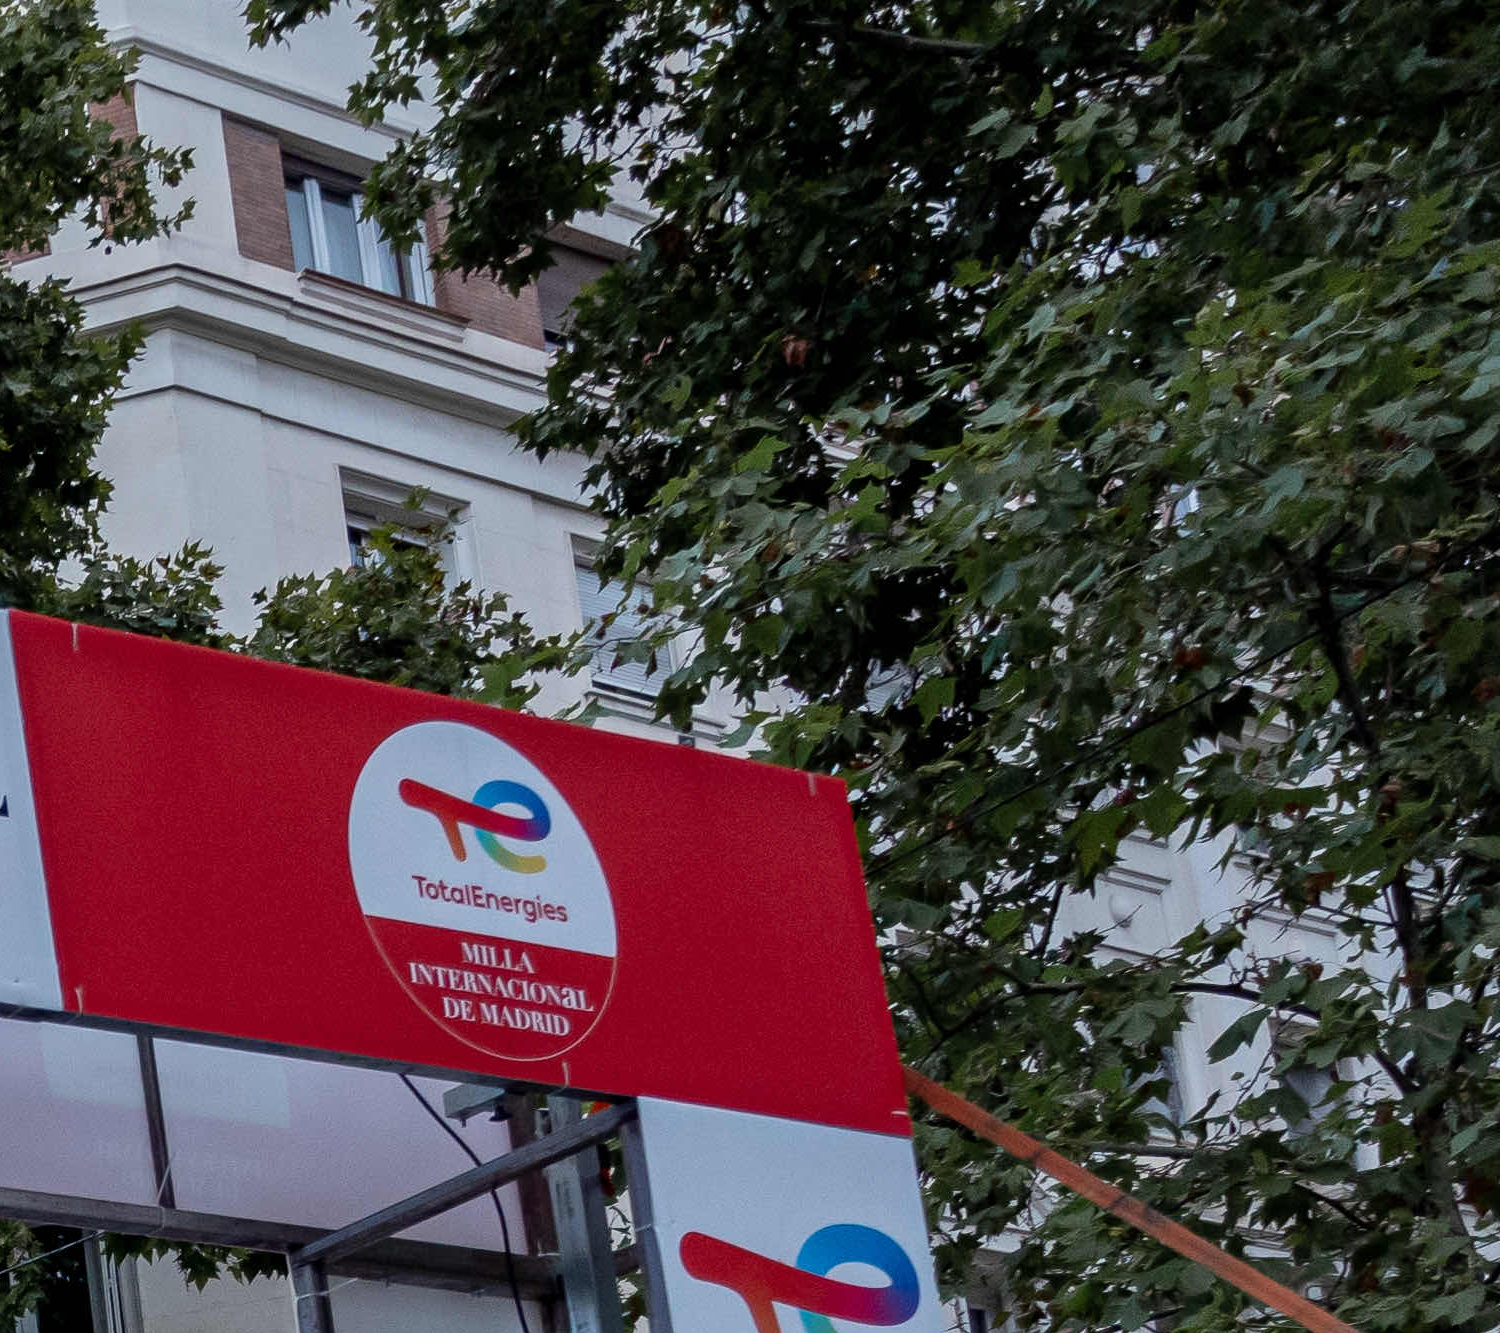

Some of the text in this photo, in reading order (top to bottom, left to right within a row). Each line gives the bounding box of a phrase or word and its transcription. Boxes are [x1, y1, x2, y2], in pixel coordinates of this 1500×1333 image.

[411, 873, 570, 924] TotalEnergies
[460, 940, 536, 975] MILLA
[442, 996, 572, 1038] DE MADRID
